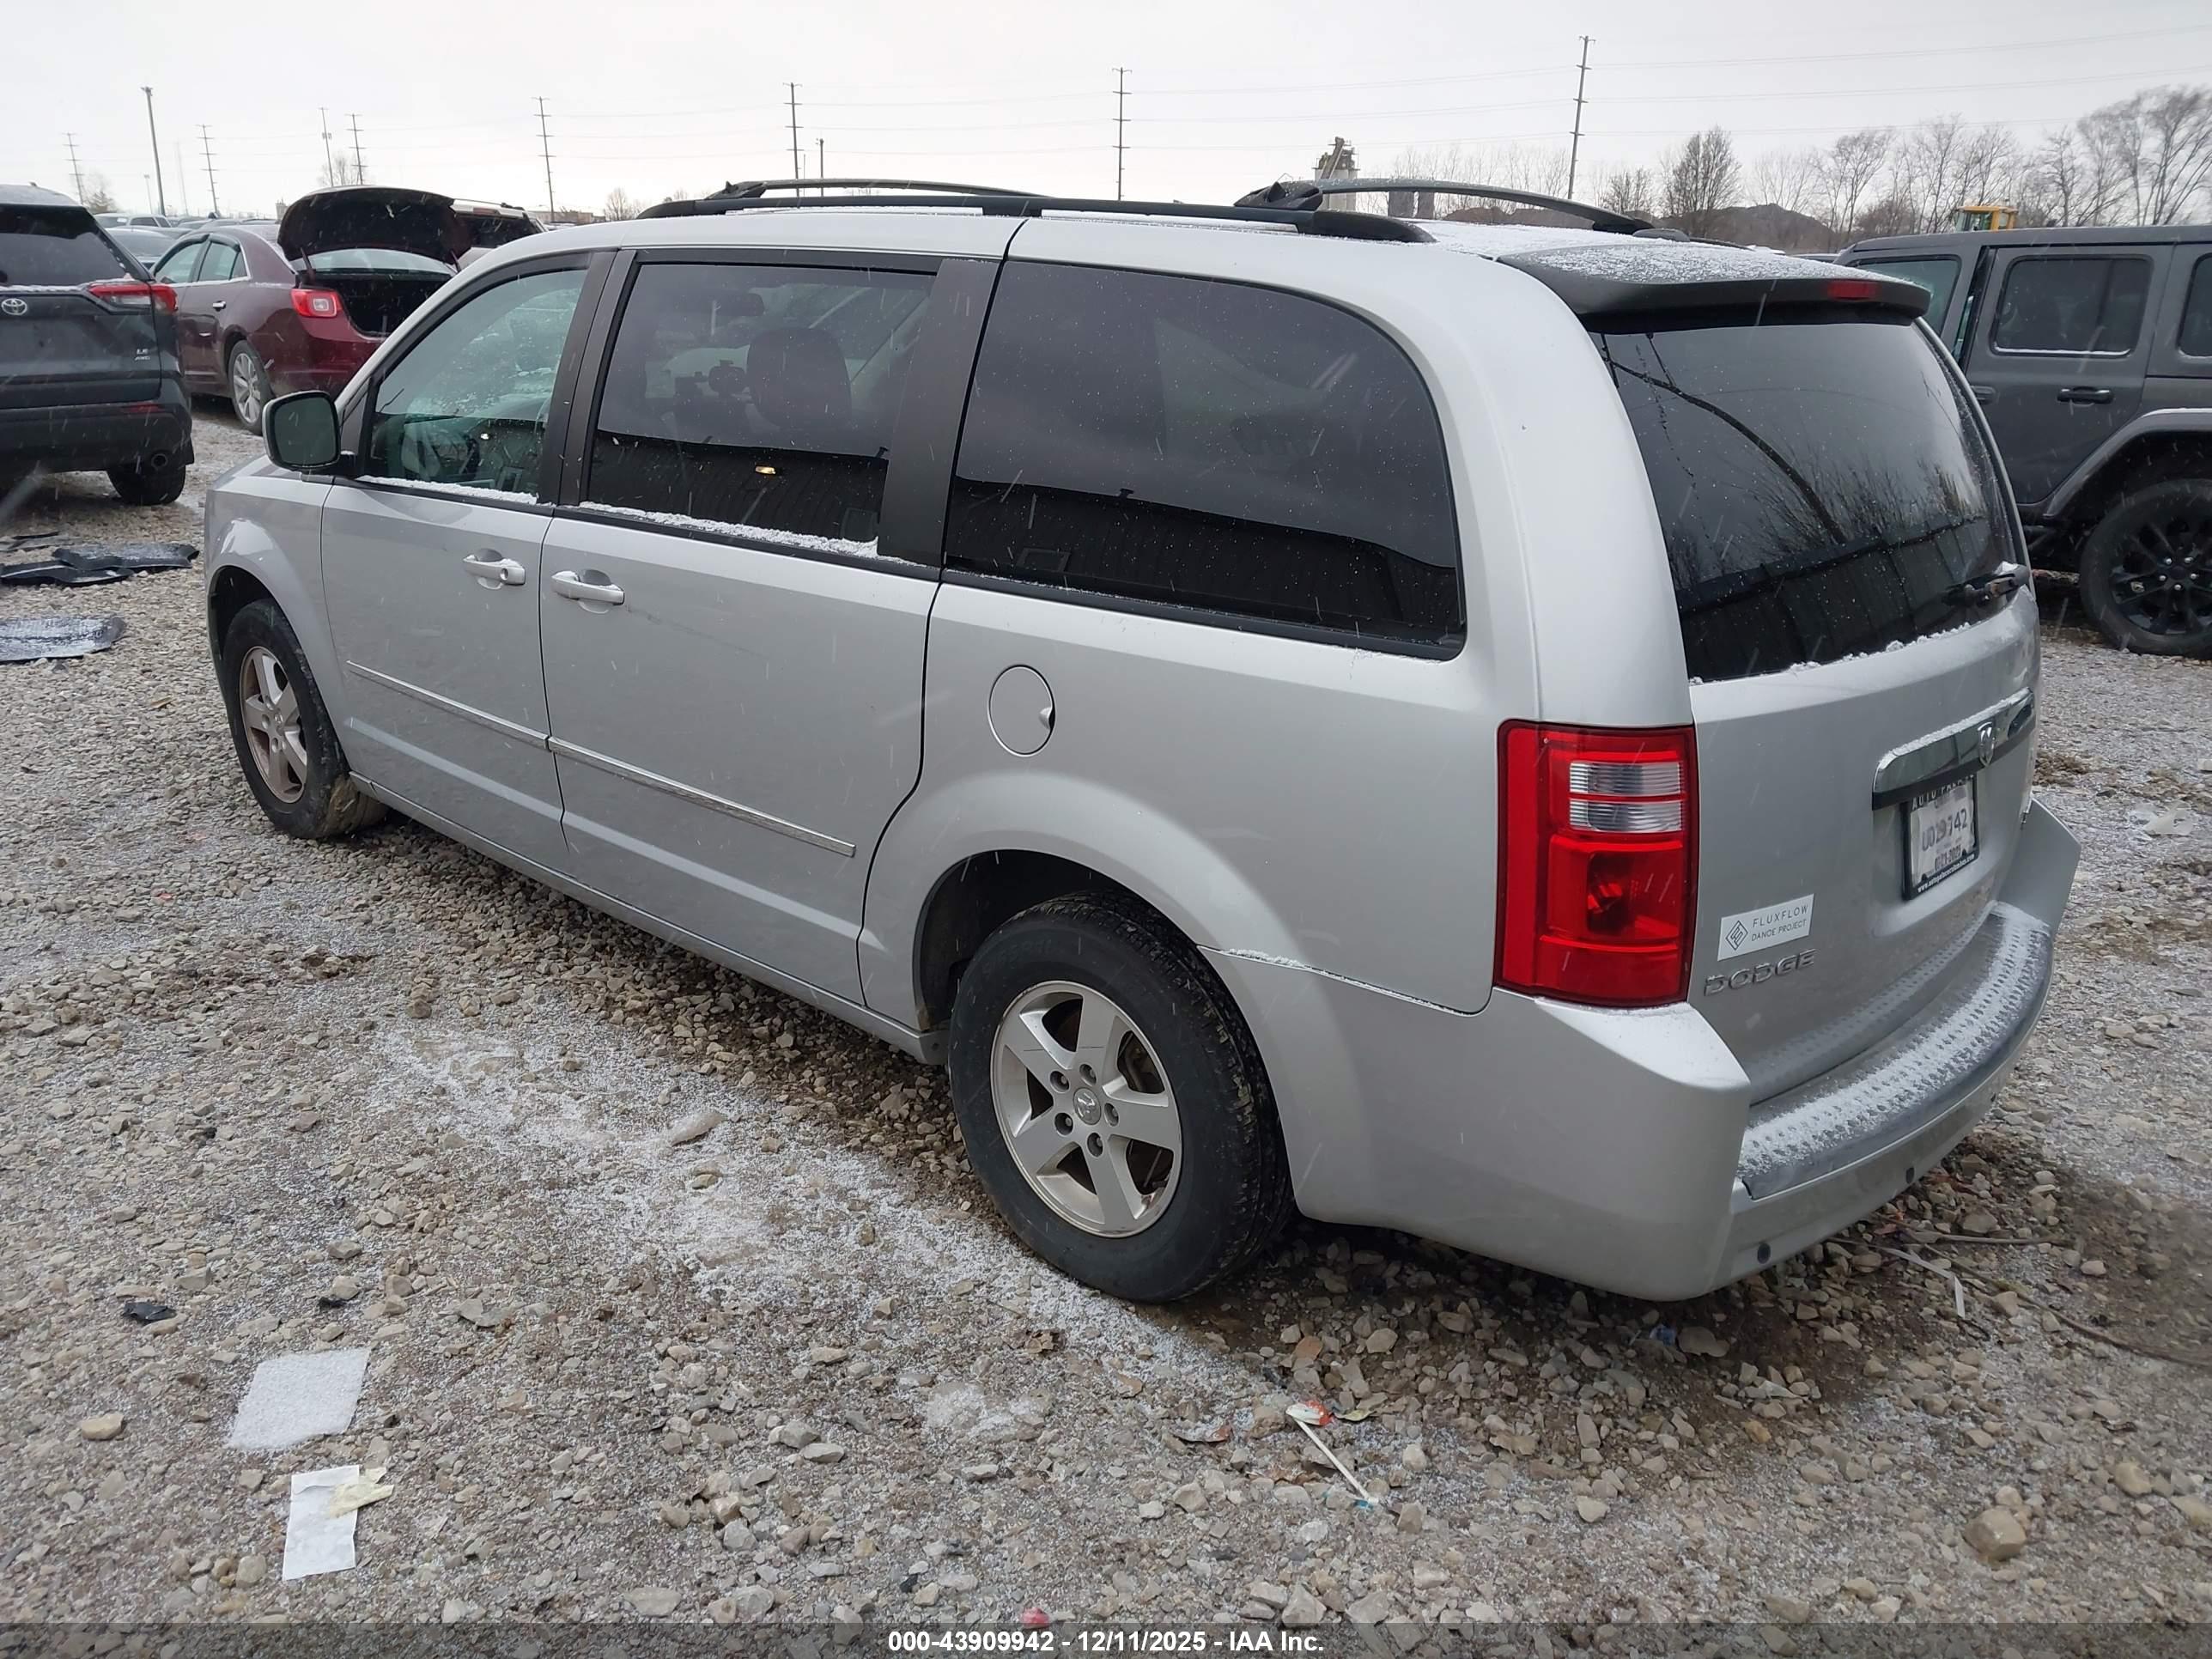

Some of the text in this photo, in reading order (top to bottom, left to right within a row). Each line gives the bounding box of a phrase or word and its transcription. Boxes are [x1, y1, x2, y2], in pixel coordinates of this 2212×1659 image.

[1753, 904, 1808, 927] FLUXFLOW
[1751, 919, 1808, 942] DANCE PROJECT
[1704, 948, 1817, 996] DODGE
